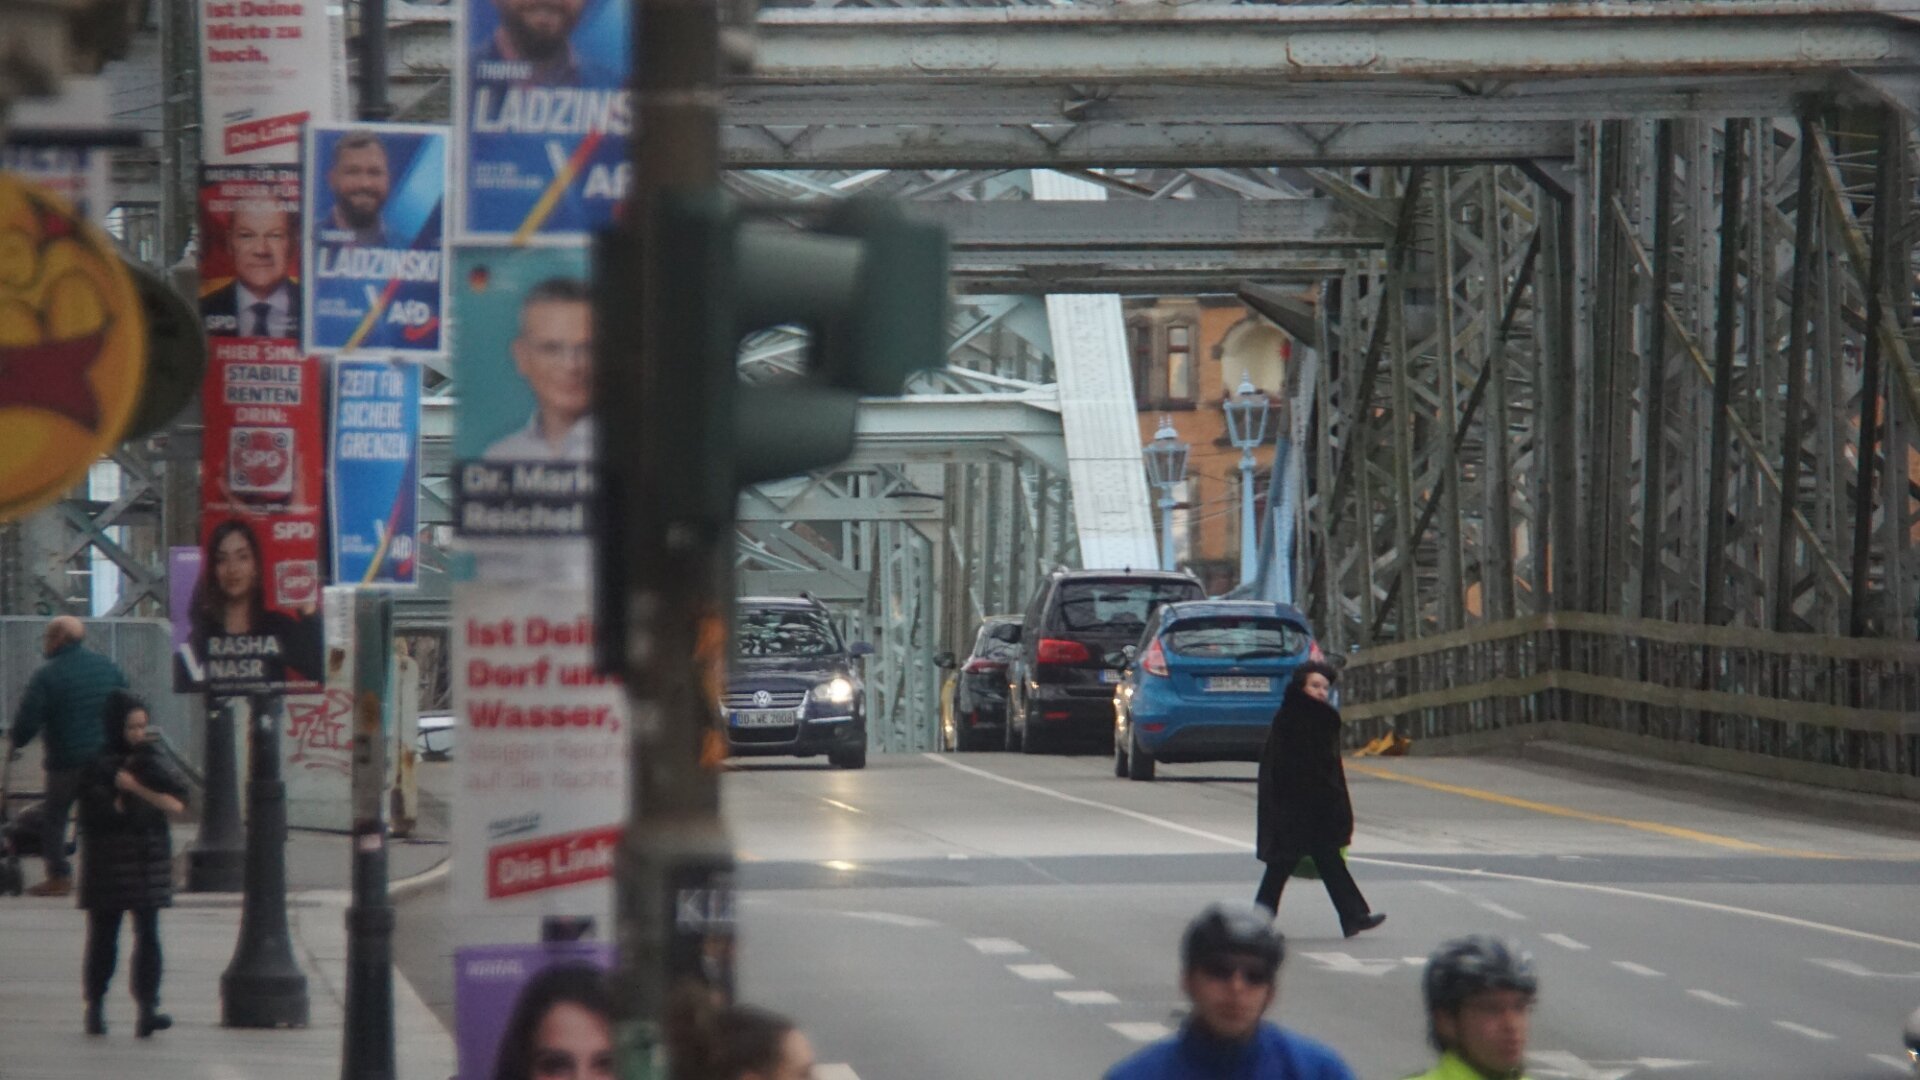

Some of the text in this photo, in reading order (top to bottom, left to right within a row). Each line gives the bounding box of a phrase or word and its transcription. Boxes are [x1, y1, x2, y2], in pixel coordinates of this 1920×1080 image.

[206, 1, 303, 18] Ist Deine
[206, 24, 302, 40] Miete zu
[475, 86, 633, 136] LADZINS
[259, 120, 299, 140] Link
[583, 164, 631, 199] Af
[318, 247, 440, 281] LADZINSKI
[207, 315, 236, 329] SPD
[387, 299, 430, 325] AfD
[215, 344, 257, 358] HIER
[228, 366, 299, 382] STABILE
[341, 369, 403, 397] ZEIT FÜR
[226, 387, 298, 402] RENTEN
[235, 408, 287, 423] DRIN:
[240, 448, 282, 467] SPD
[512, 464, 595, 493] Mark
[273, 521, 315, 540] SPD
[284, 576, 312, 589] SPD
[467, 617, 514, 646] Ist
[208, 635, 280, 655] RASHA
[210, 660, 264, 678] NASR
[467, 658, 550, 687] Dorf
[467, 700, 620, 732] Wasser,
[499, 840, 616, 886] Die Link
